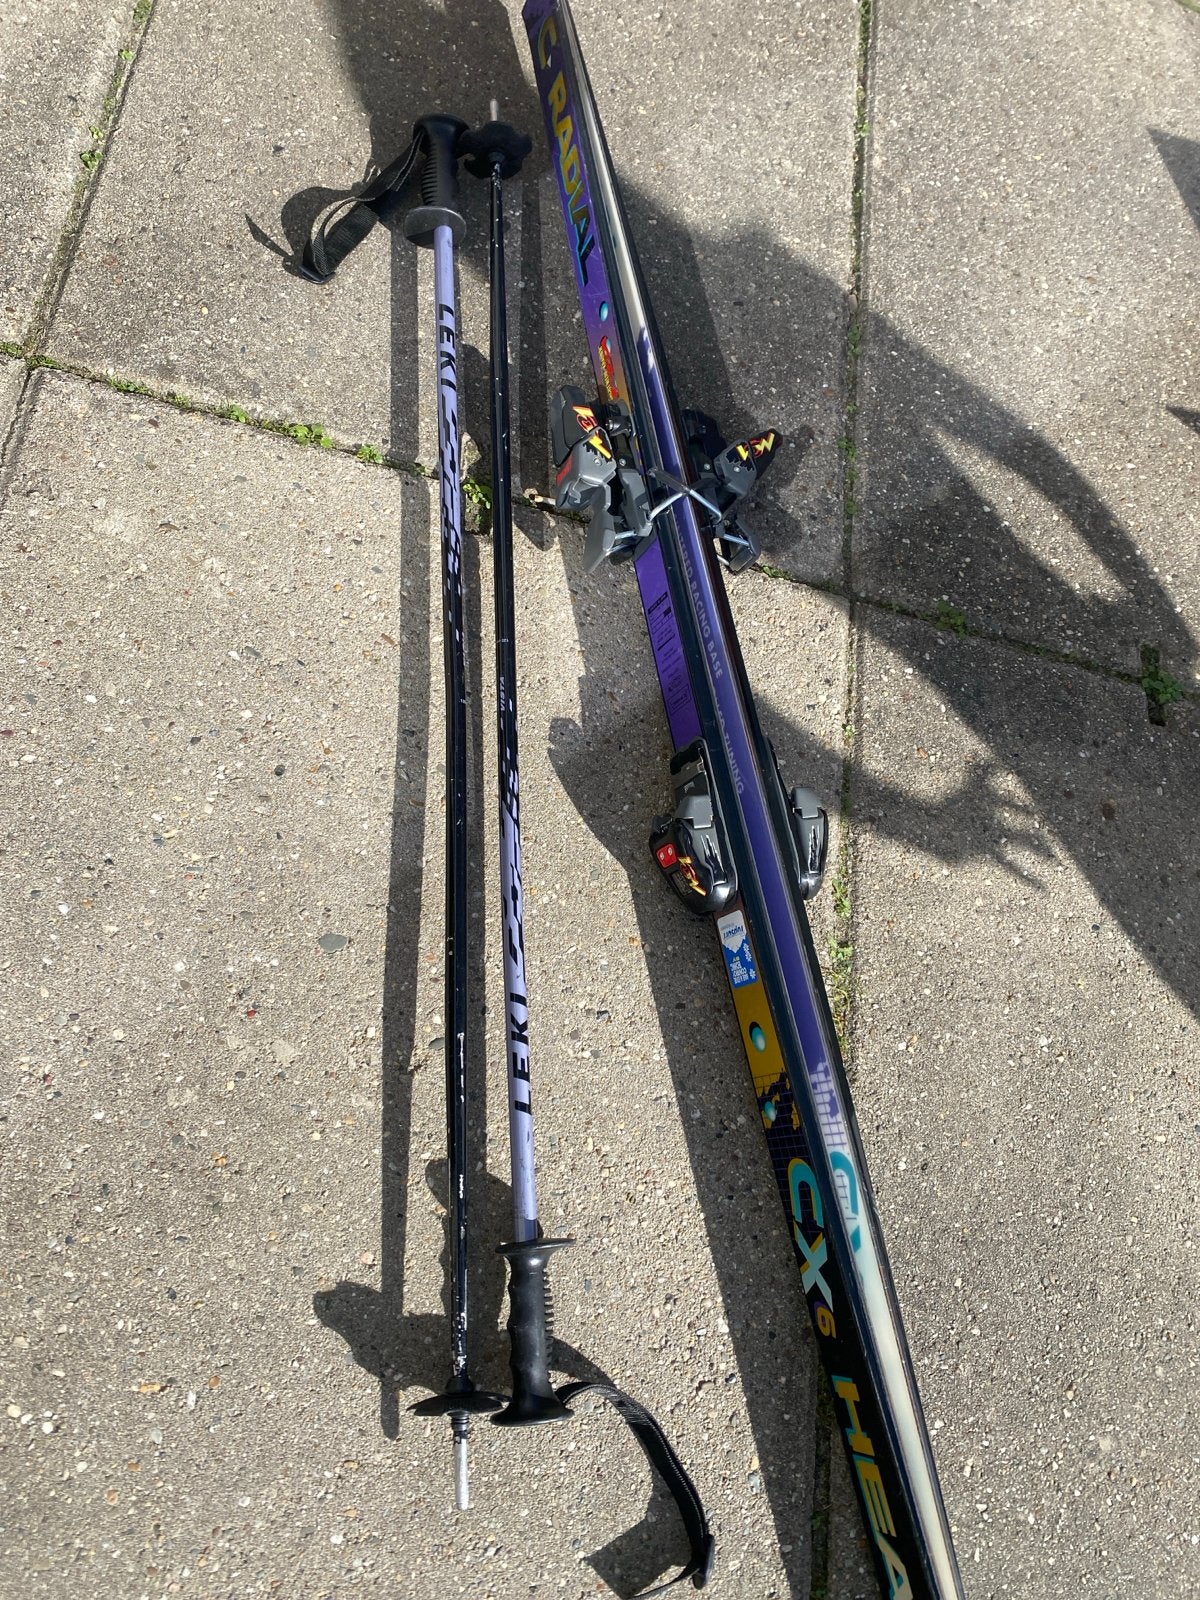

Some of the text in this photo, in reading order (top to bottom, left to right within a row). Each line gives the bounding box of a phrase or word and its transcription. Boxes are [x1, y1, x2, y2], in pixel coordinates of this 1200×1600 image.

[548, 70, 596, 287] RADIAL
[439, 303, 458, 392] LEKI
[691, 581, 711, 639] RACING
[707, 641, 723, 679] BASE
[510, 992, 532, 1116] LEKI
[787, 1157, 837, 1339] CX 6
